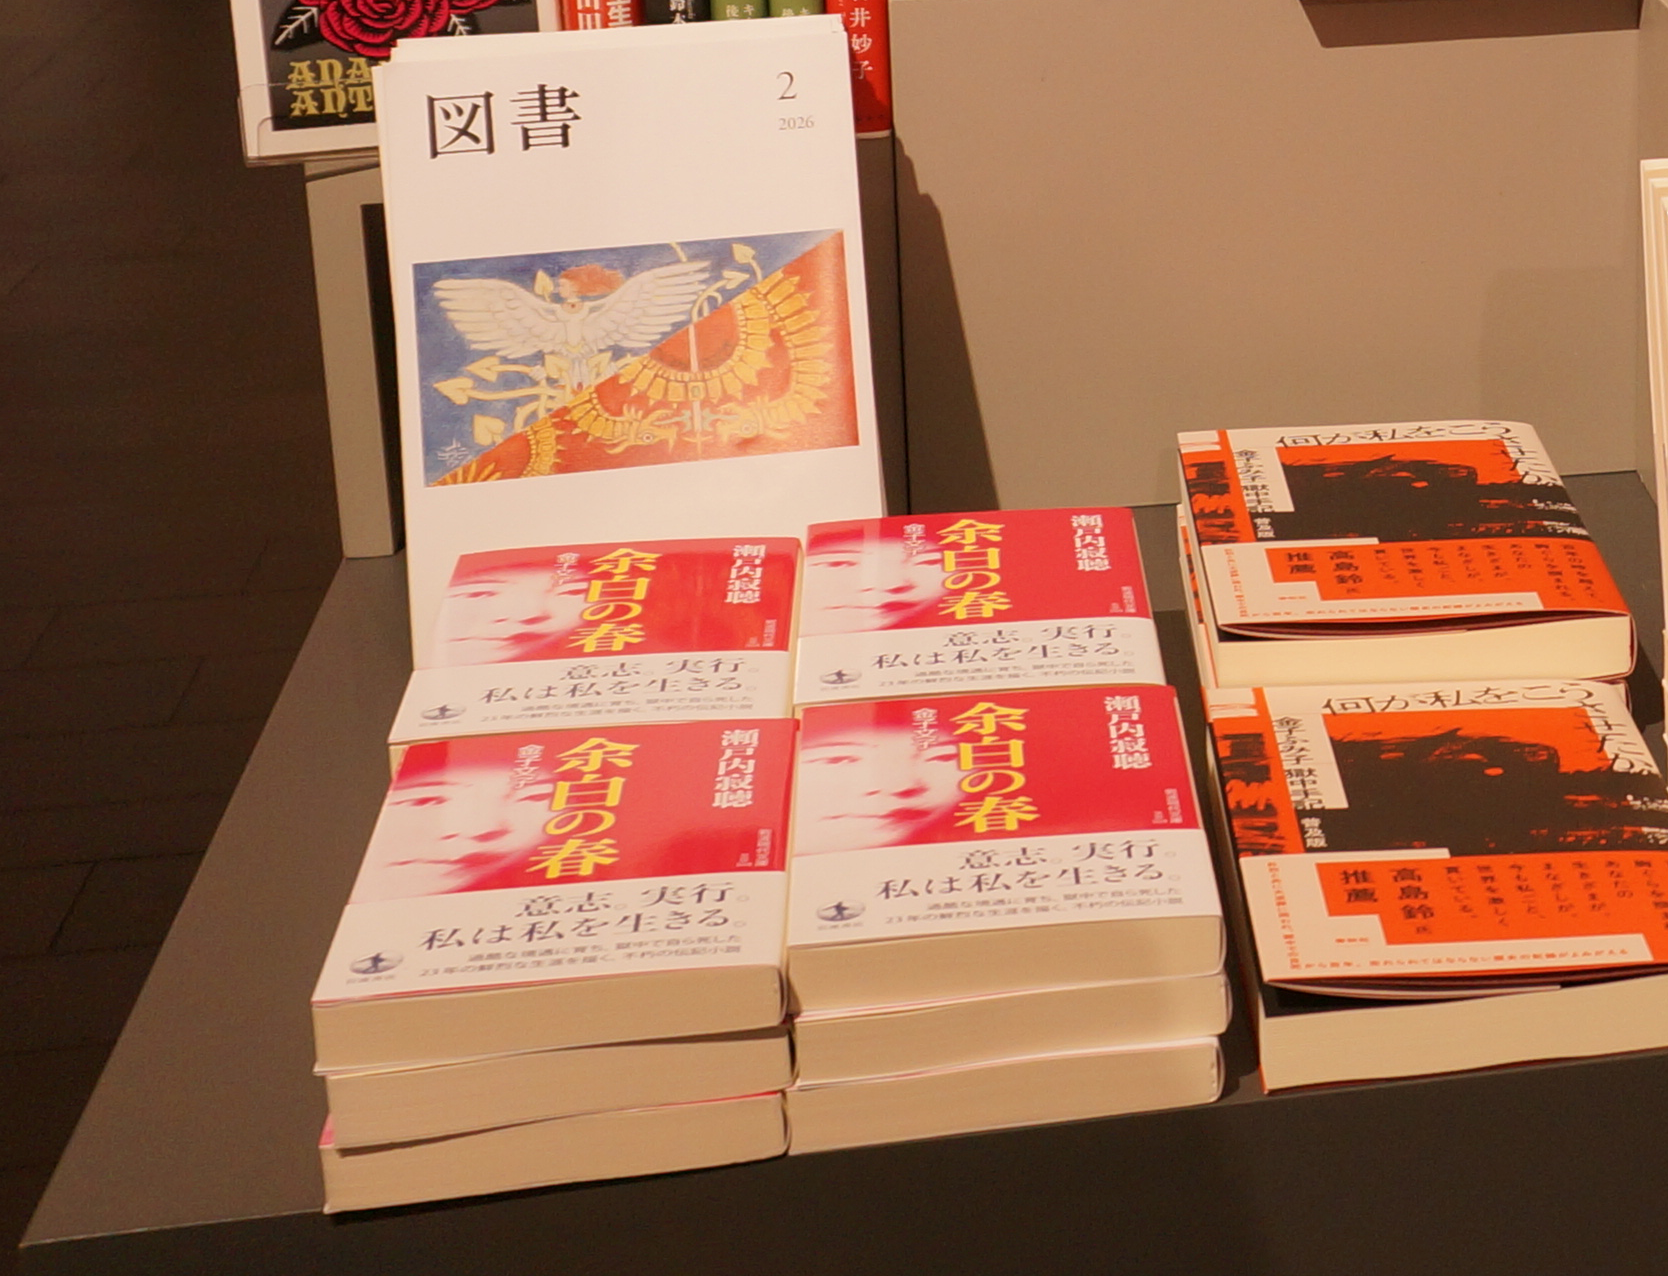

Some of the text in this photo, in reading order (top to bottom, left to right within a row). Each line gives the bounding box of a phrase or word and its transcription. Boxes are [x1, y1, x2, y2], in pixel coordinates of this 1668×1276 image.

[776, 70, 799, 101] 2
[424, 83, 583, 160] 図書
[778, 115, 816, 131] 2026
[937, 518, 1013, 622] 余白の春
[1069, 513, 1112, 573] 瀬戸内寂聴
[1284, 551, 1317, 576] 推薦
[1328, 550, 1365, 585] 高島鈴
[566, 547, 663, 654] 余白の春
[724, 542, 768, 606] 瀬戸内寂聴
[869, 641, 1133, 669] 私は私を生きる。
[480, 676, 758, 704] 私は私を生きる。
[1102, 694, 1153, 771] 瀬戸内寂聴
[711, 728, 761, 810] 瀬戸内寂聴
[950, 701, 1041, 834] 余白の春
[528, 736, 640, 880] 余白の春
[875, 863, 1182, 900] 私は私を生きる。
[1338, 868, 1378, 905] 推薦
[1391, 866, 1436, 920] 高島鈴
[417, 908, 748, 952] 私は私を生きる。
